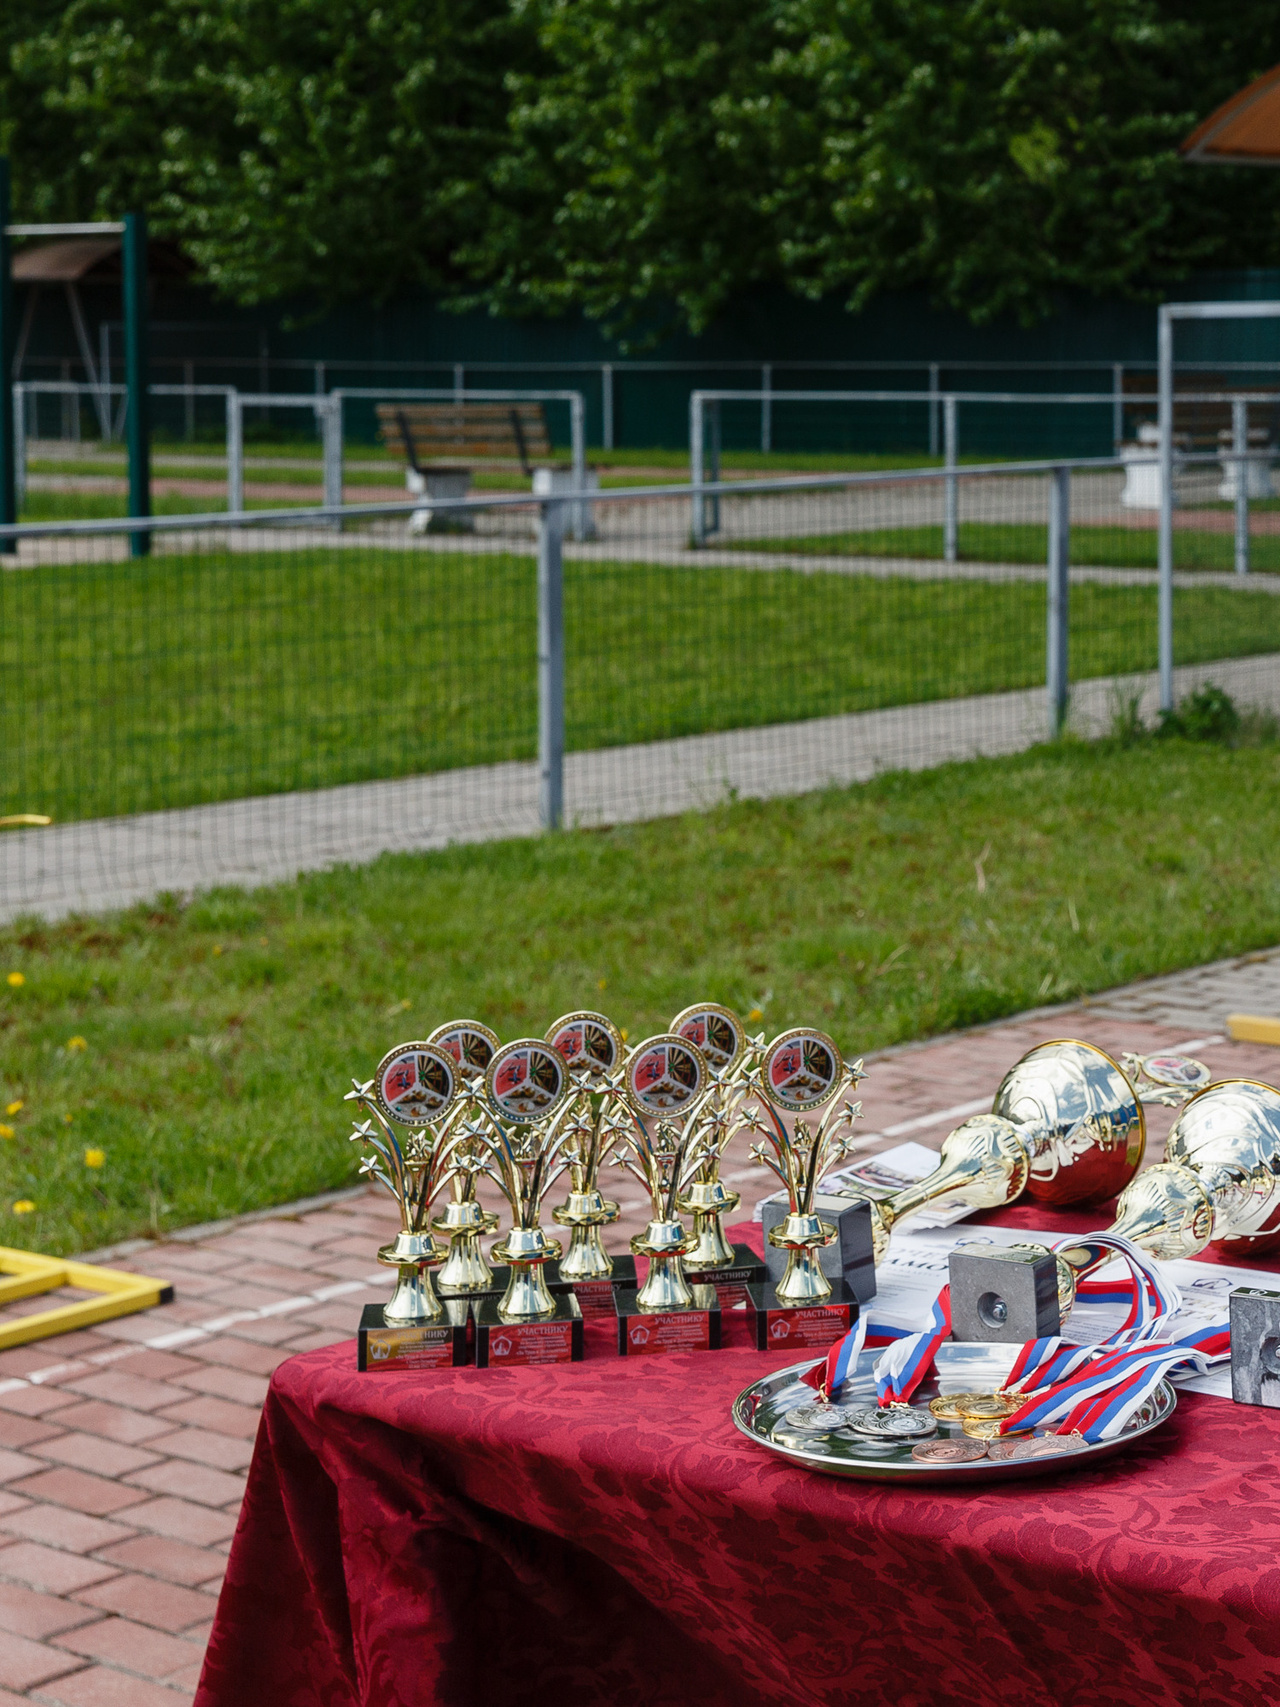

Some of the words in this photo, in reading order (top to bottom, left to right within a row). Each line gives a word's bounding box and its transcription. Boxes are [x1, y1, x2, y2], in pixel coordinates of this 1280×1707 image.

[704, 1270, 752, 1282] УЧАСТНИКУ
[795, 1308, 845, 1319] УЧАСТНИКУ
[655, 1314, 704, 1325] УЧАСТНИКУ
[517, 1325, 568, 1336] УЧАСТНИКУ
